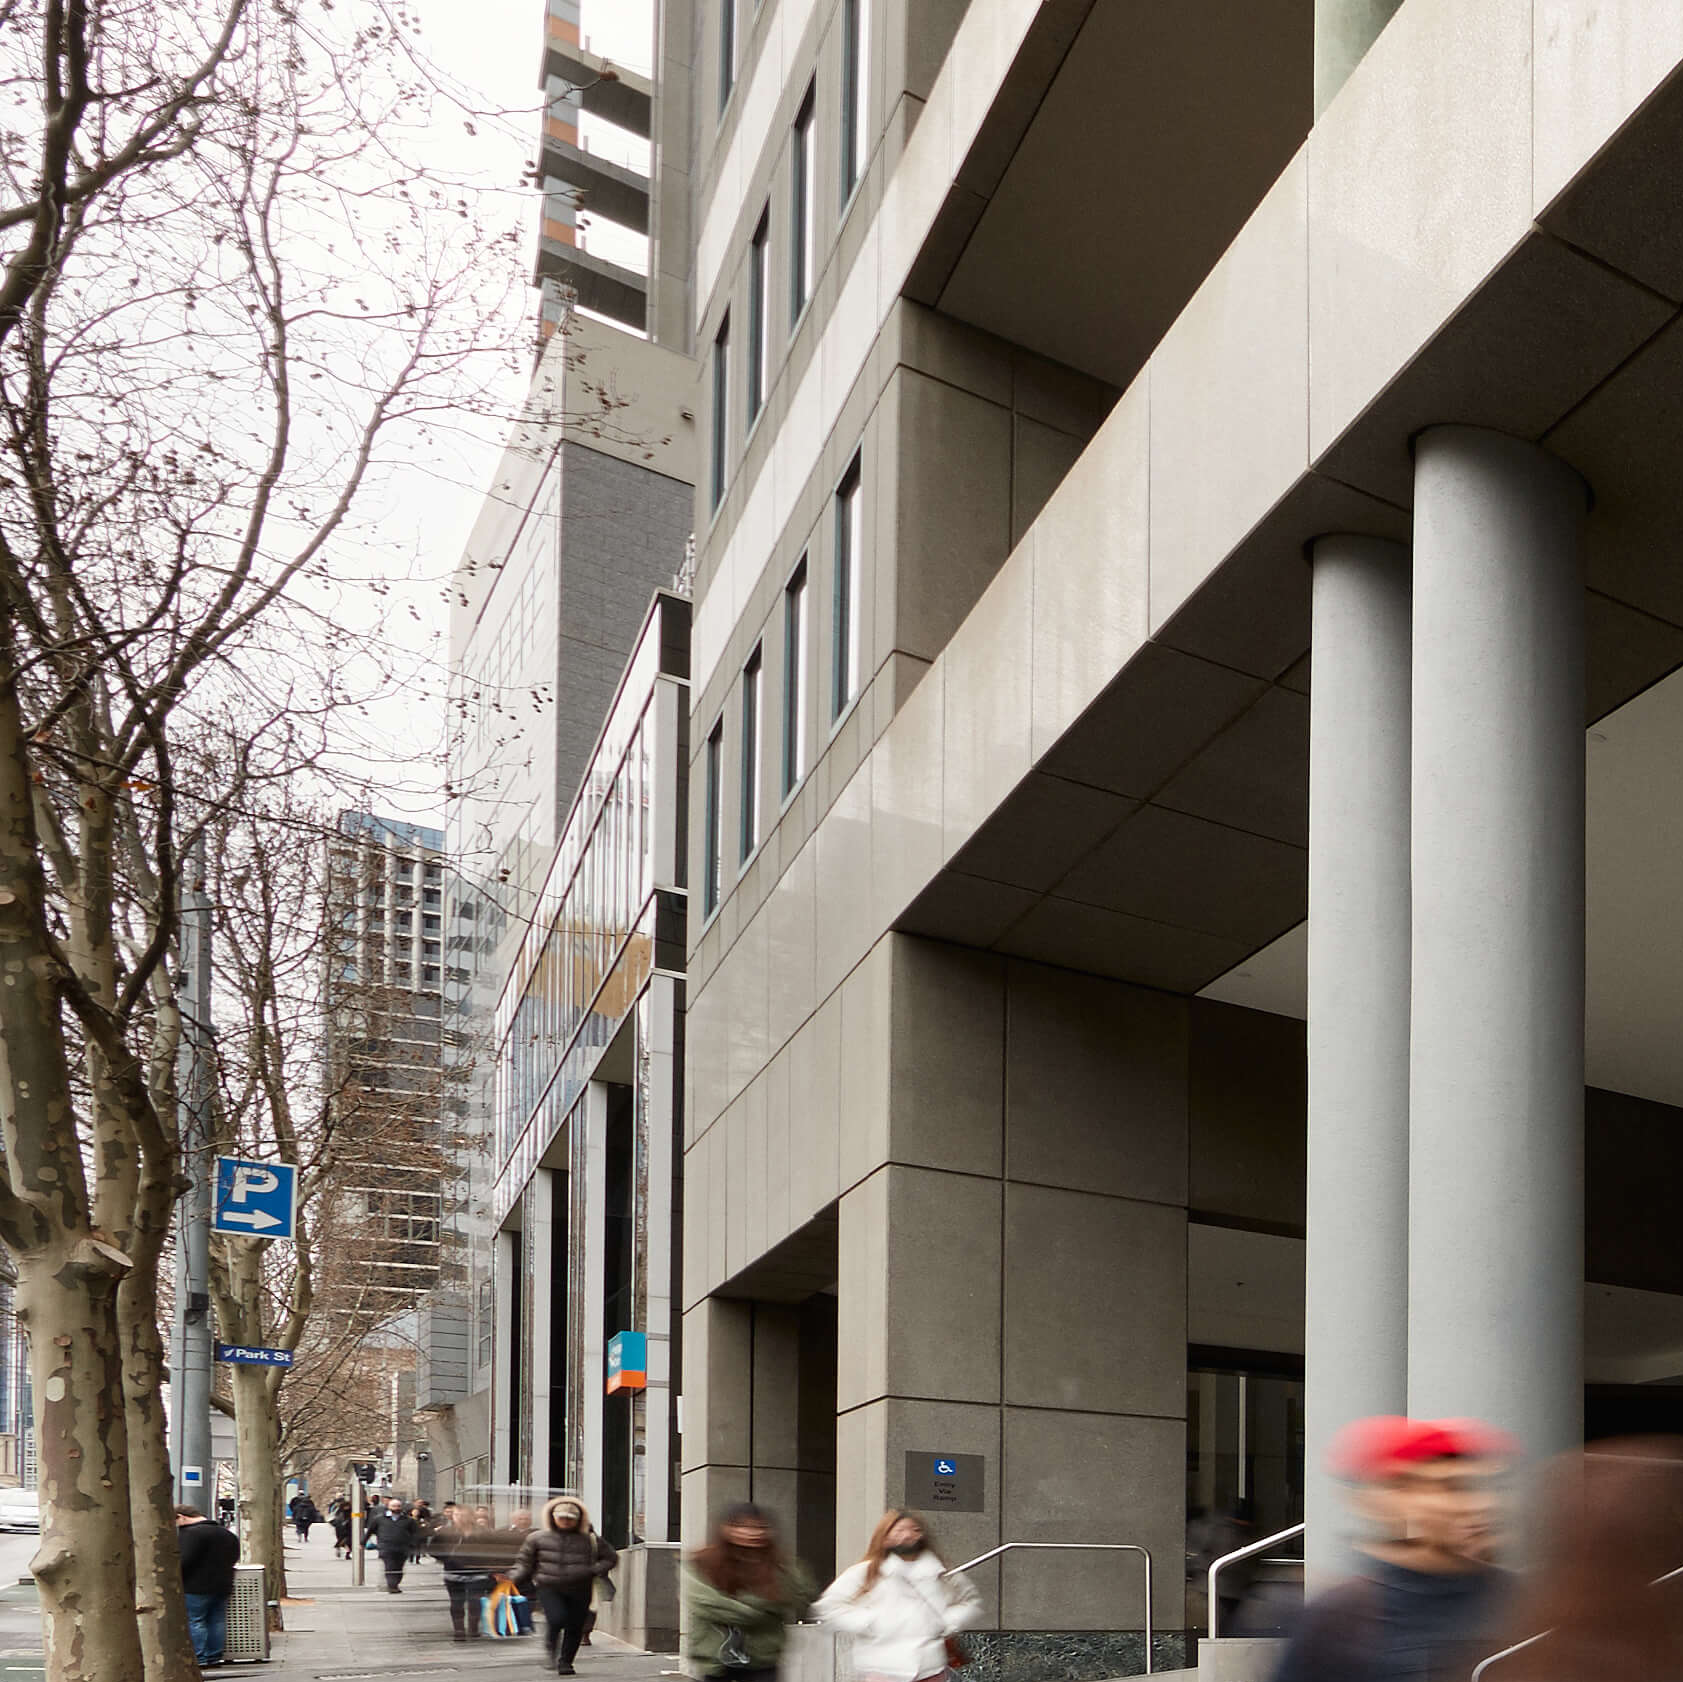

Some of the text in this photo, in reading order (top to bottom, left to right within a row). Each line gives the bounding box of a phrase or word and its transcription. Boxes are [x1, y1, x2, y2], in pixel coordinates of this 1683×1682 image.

[231, 1165, 280, 1203] P
[235, 1348, 291, 1362] Park St
